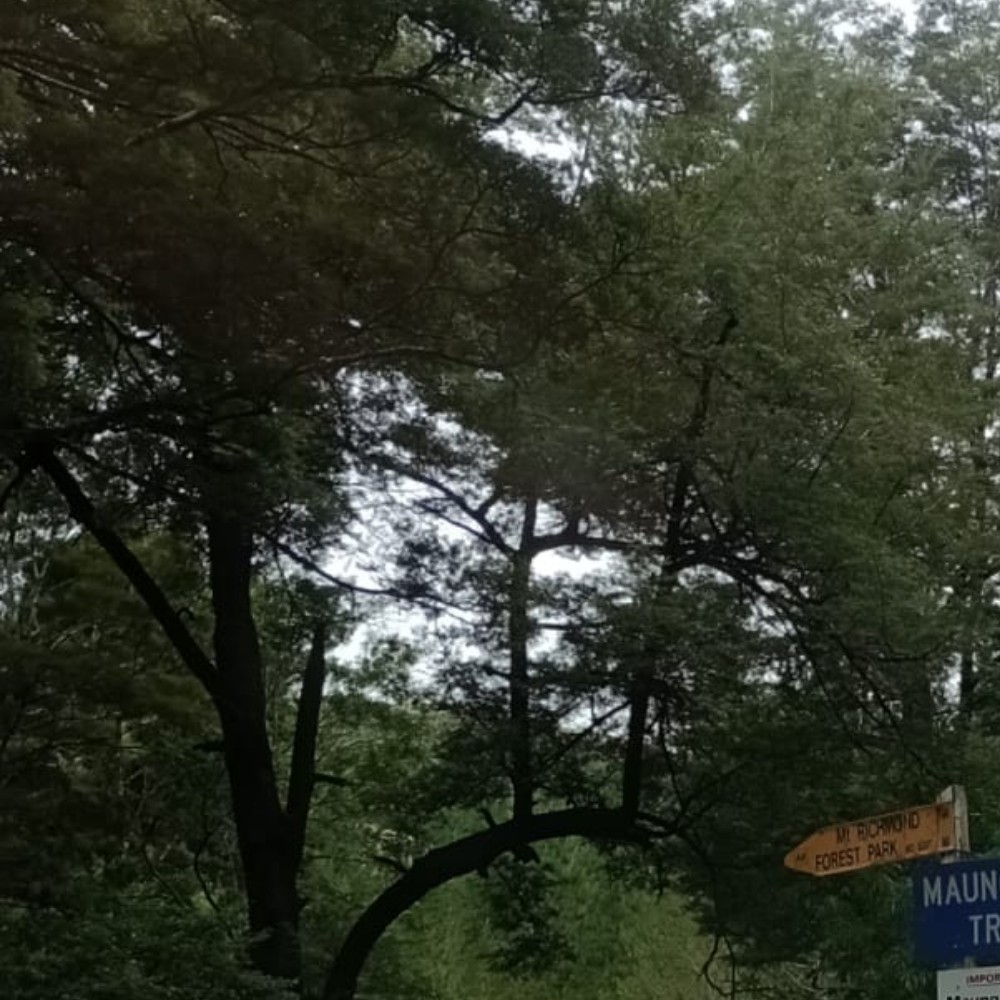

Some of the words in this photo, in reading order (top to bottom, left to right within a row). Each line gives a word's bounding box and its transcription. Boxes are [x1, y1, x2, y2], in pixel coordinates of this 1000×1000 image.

[857, 812, 920, 840] RICHMOND
[815, 848, 860, 871] FOREST
[868, 842, 897, 858] PARK
